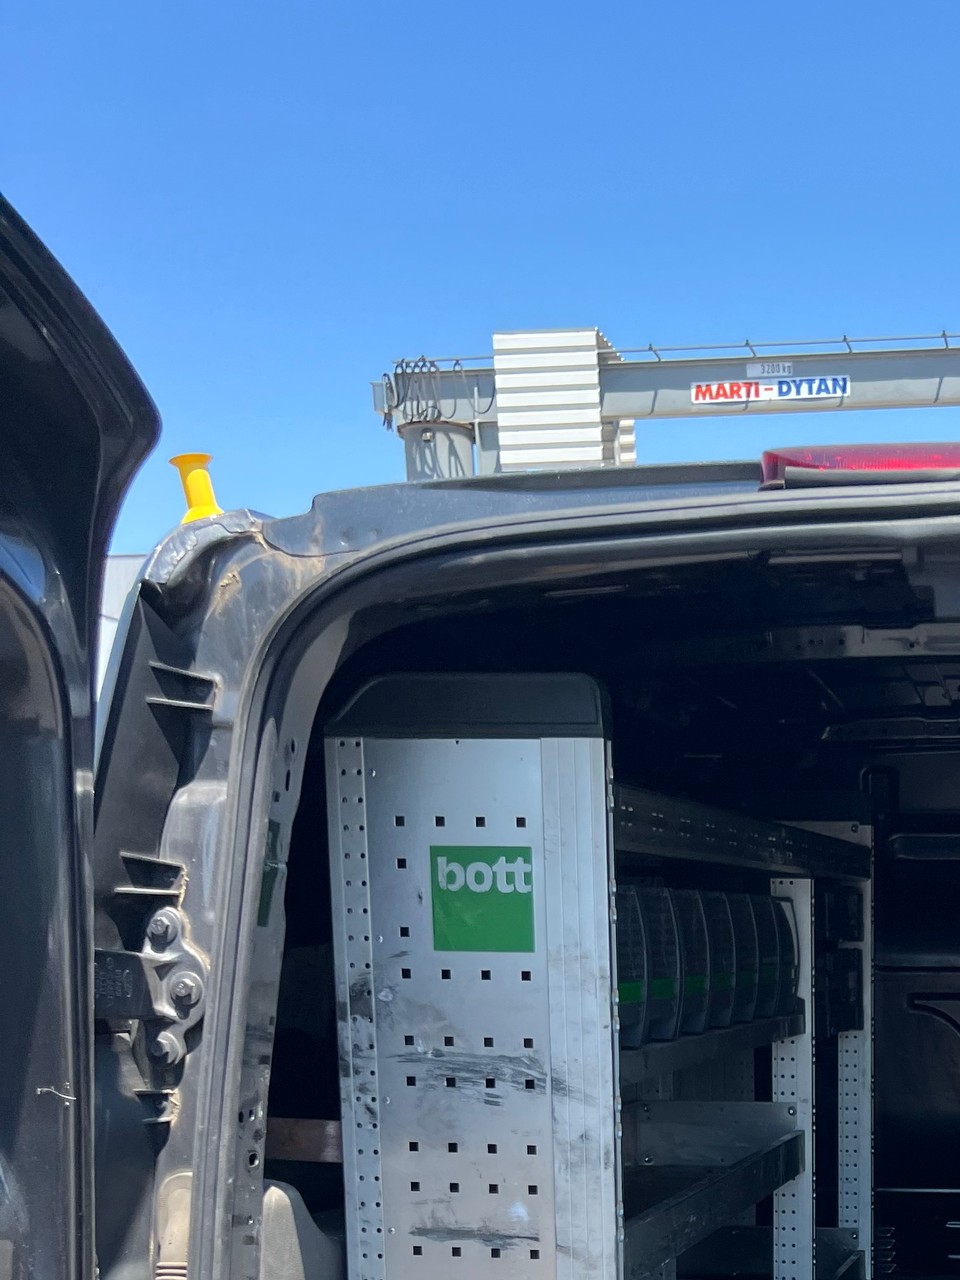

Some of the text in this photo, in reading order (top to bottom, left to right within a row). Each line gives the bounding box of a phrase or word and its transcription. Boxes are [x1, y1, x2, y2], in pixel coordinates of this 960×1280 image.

[694, 381, 760, 401] MARTI
[778, 377, 847, 397] DYTAN
[437, 856, 532, 894] bott
